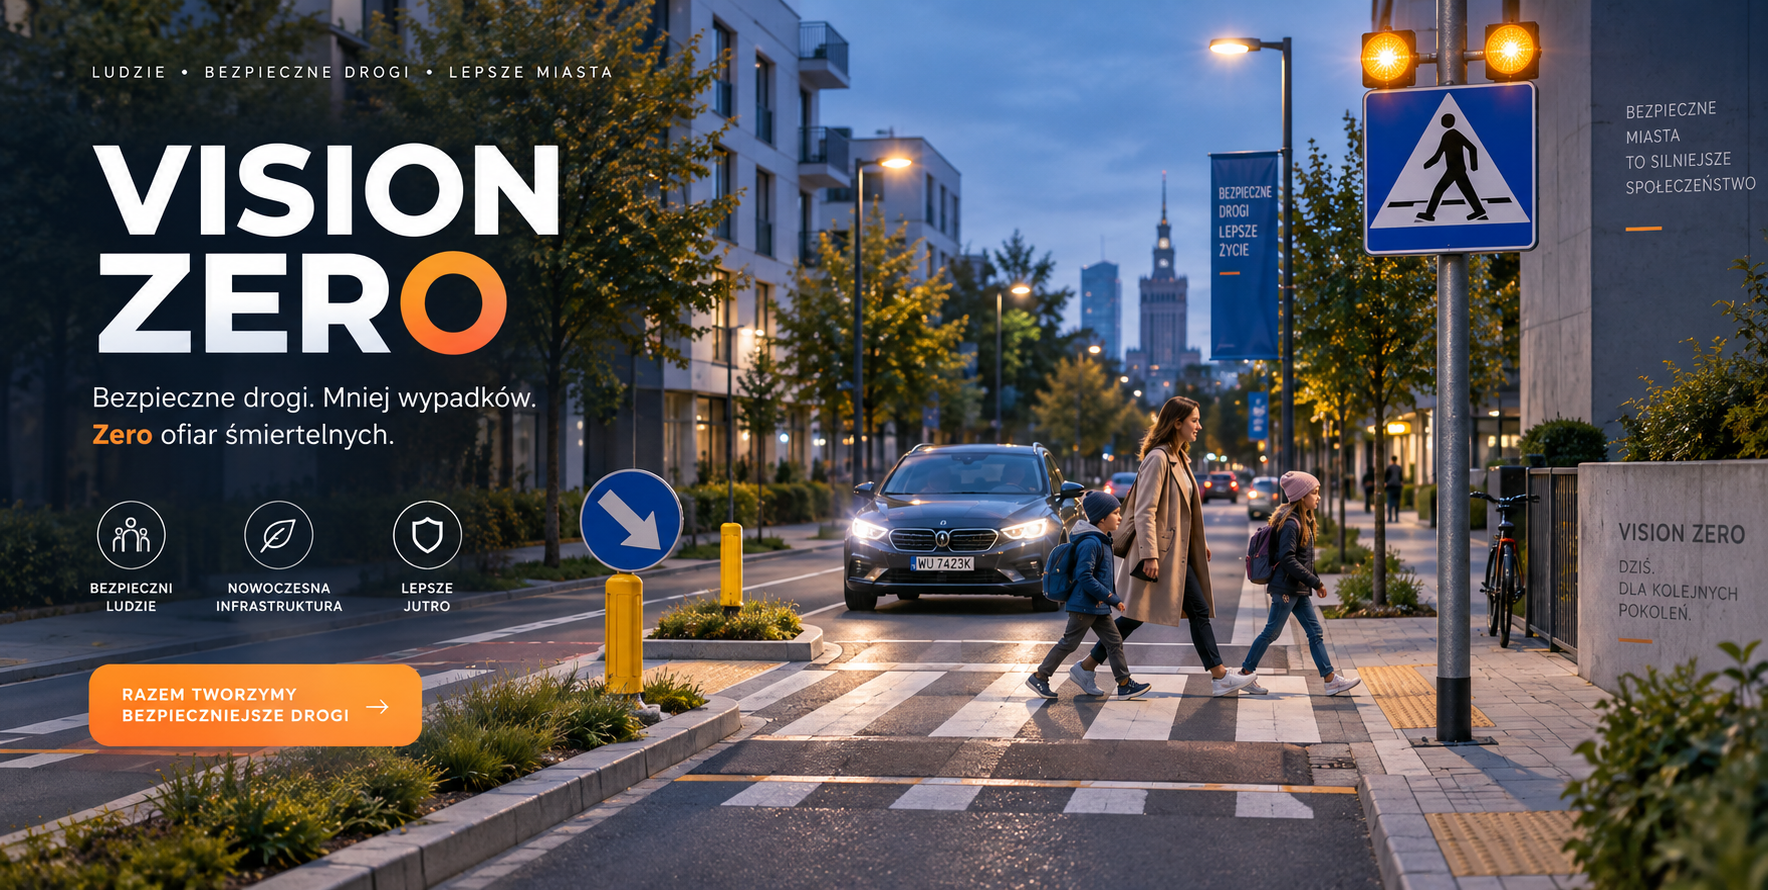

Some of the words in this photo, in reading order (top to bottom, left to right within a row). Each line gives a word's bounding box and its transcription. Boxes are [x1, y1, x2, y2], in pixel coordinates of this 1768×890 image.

[1626, 100, 1717, 120] BEZPIECZNE
[1626, 128, 1681, 144] MIASTA
[1625, 155, 1646, 170] TO
[1650, 151, 1732, 169] SILNIEJSZE
[1219, 186, 1272, 200] BEZPIECZNE
[1625, 174, 1757, 195] SPOŁECZEŃSTWO
[1219, 204, 1249, 218] DROGI
[1219, 224, 1258, 238] LEPSZE
[1618, 522, 1685, 543] VISION
[1692, 523, 1746, 545] ZERO
[917, 557, 934, 569] WU
[937, 557, 971, 569] 7423K
[1619, 581, 1648, 597] DLA
[1652, 582, 1739, 601] KOLEJNYCH
[1618, 603, 1692, 622] POKOLEŃ.
